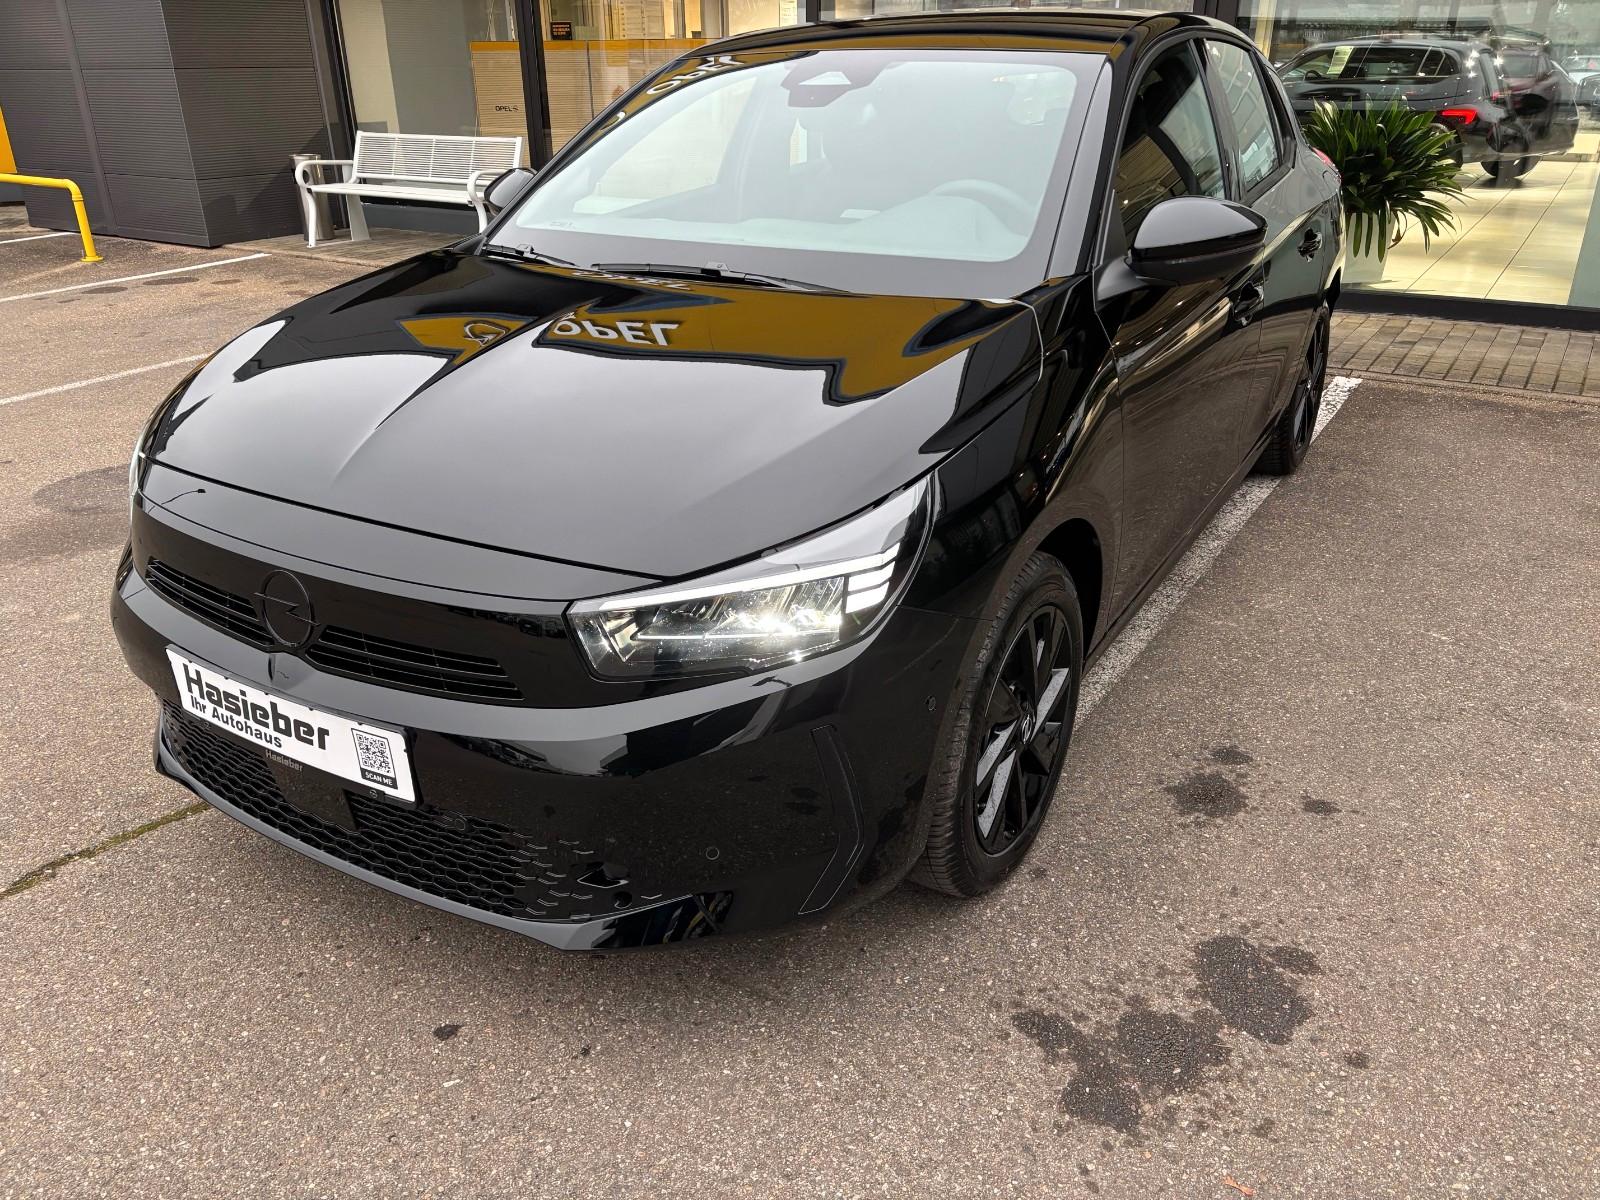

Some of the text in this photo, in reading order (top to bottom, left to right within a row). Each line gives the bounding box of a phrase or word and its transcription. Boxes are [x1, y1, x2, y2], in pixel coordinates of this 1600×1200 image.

[182, 662, 330, 750] Hasieber
[190, 694, 283, 749] Ihr Autohaus
[265, 749, 303, 771] Hasieber
[365, 771, 393, 786] SCAN ME
